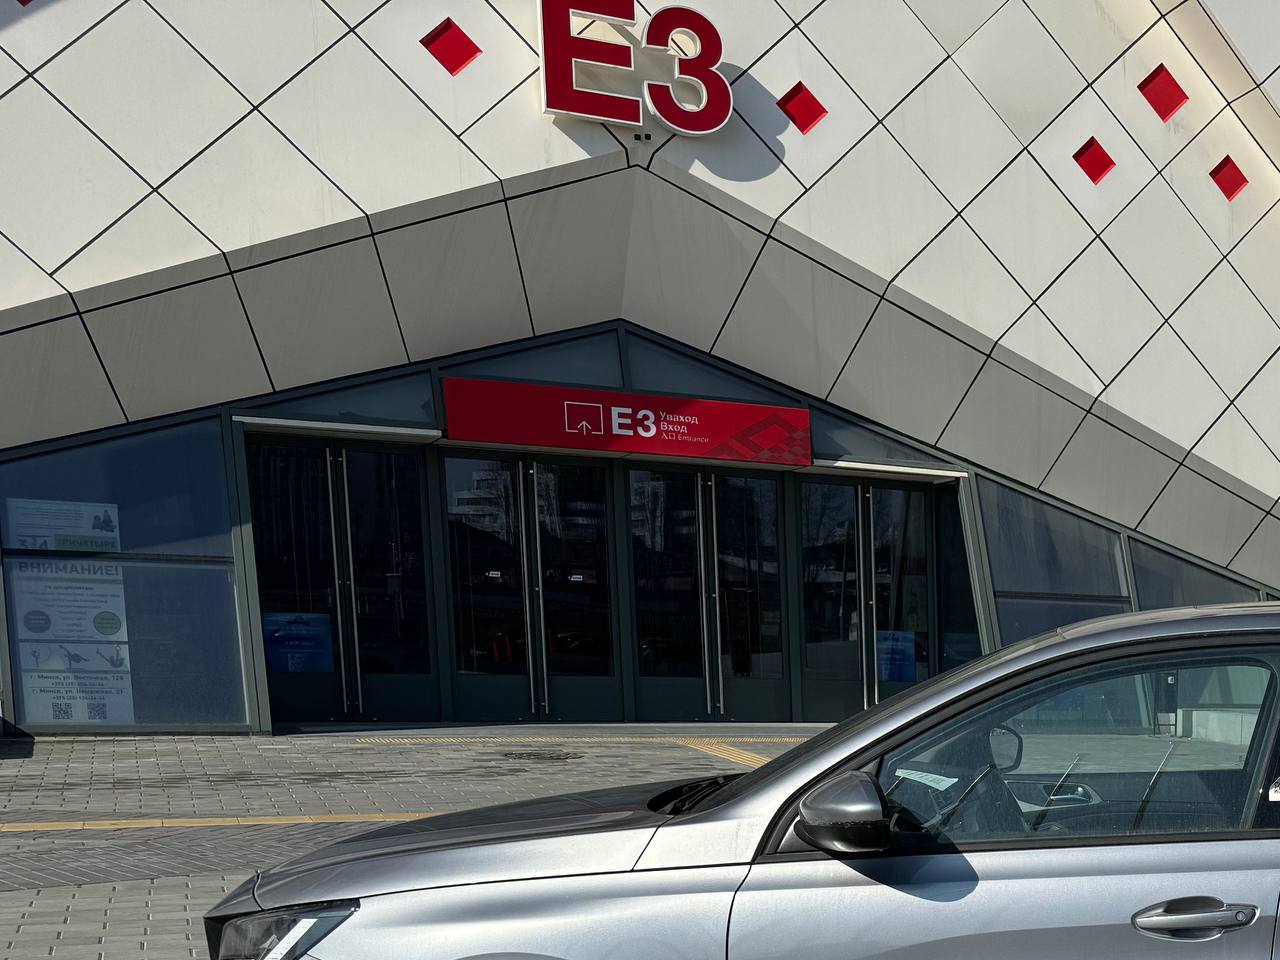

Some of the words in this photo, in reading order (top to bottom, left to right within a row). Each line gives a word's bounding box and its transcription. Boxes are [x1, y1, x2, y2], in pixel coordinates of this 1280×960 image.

[538, 0, 733, 135] E3
[610, 406, 656, 437] E3
[659, 411, 699, 425] Уваход
[660, 421, 688, 433] Вход
[677, 434, 709, 443] Entrance
[18, 561, 119, 576] ВНИМАНИЕ!
